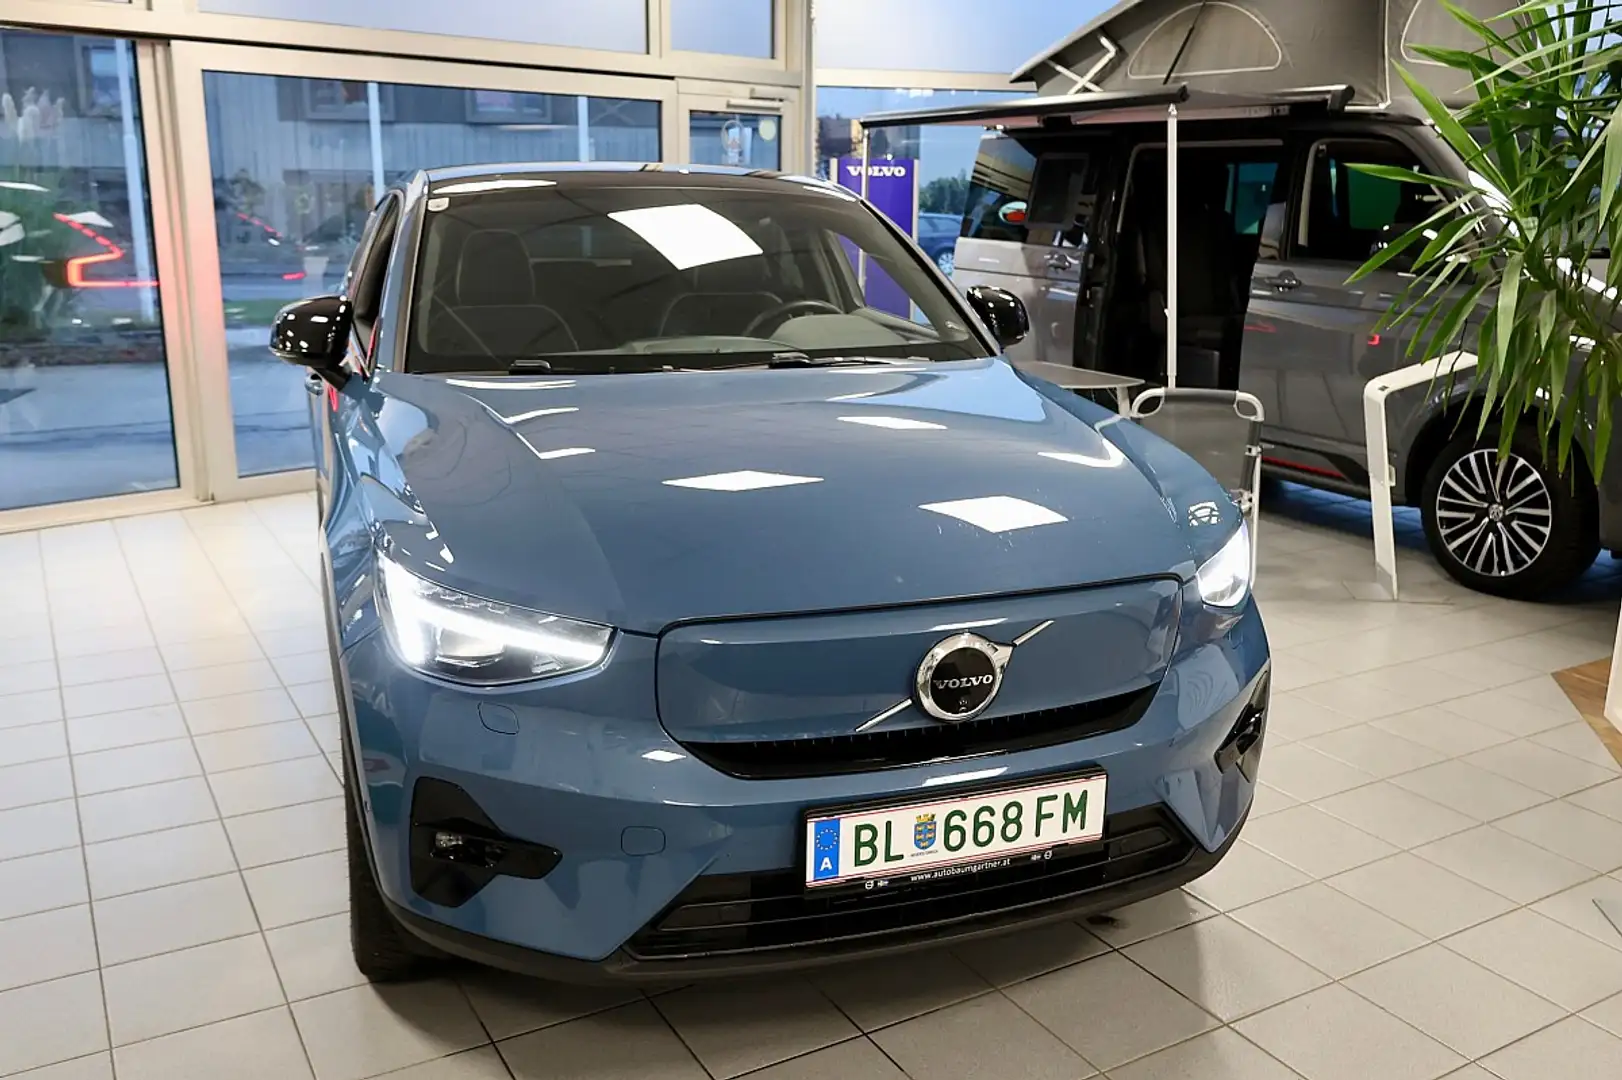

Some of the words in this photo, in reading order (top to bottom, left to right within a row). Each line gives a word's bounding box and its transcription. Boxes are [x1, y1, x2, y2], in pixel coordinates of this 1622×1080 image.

[933, 674, 994, 690] VOLVO
[854, 820, 904, 867] BL
[943, 800, 1023, 852] 668
[1035, 789, 1088, 837] FM
[819, 857, 833, 872] A
[910, 858, 1011, 882] www.autobaumgartner.at
